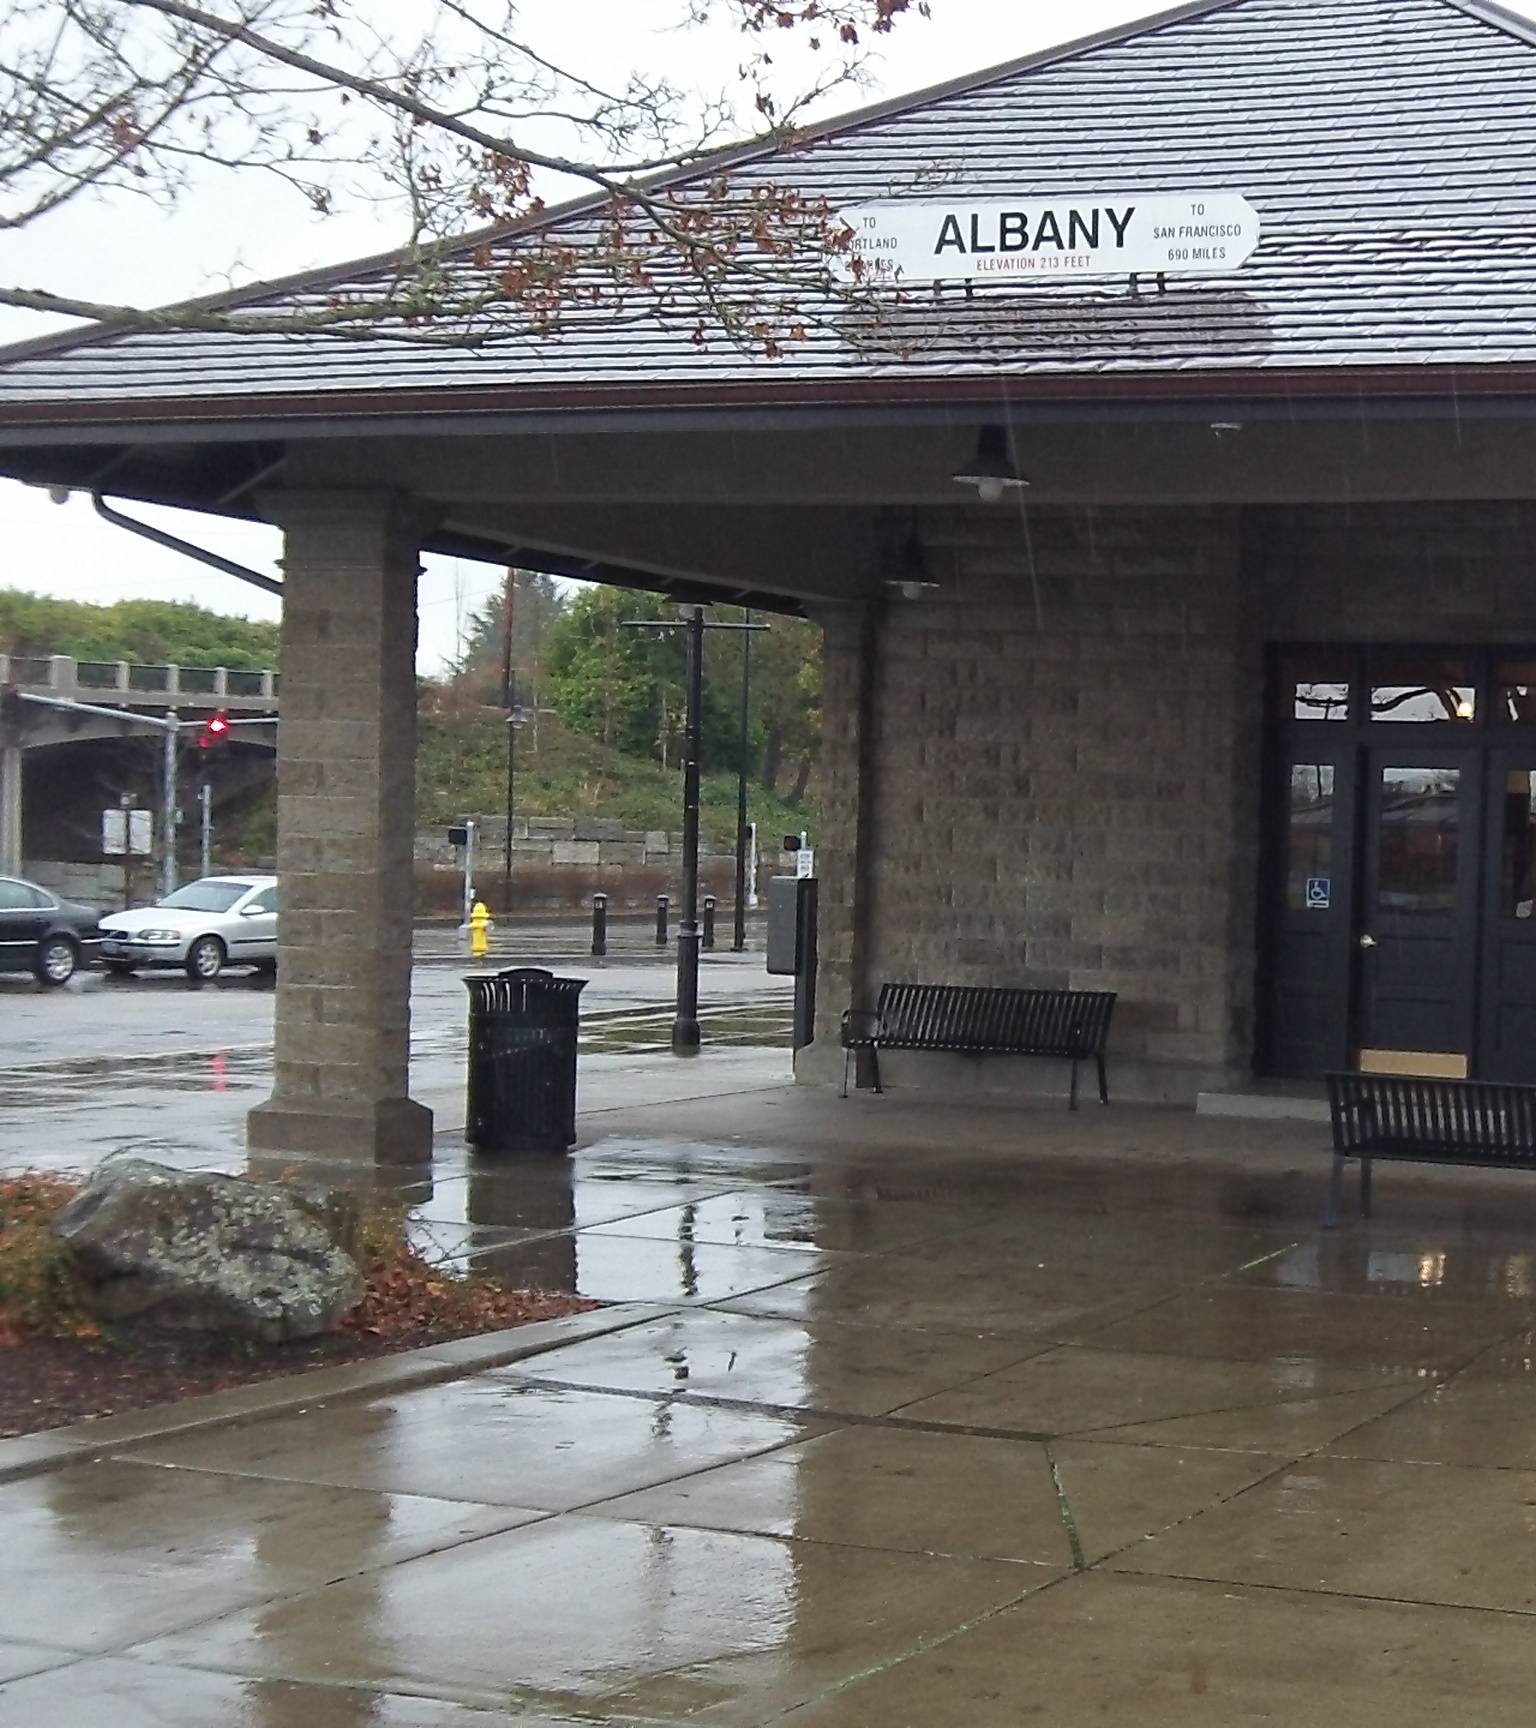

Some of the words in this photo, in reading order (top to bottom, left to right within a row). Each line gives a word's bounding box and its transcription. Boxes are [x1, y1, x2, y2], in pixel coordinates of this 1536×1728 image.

[1190, 203, 1205, 216] TO
[863, 216, 877, 229] TO
[934, 207, 1136, 255] ALBANY
[1153, 227, 1175, 239] SAN
[1179, 224, 1242, 238] FRANCISCO
[850, 236, 898, 251] ORTLAND
[1168, 248, 1189, 260] 690
[1192, 246, 1226, 259] MILES
[976, 257, 1035, 271] ELEVATION
[1040, 256, 1060, 269] 213
[1064, 255, 1091, 268] FEET
